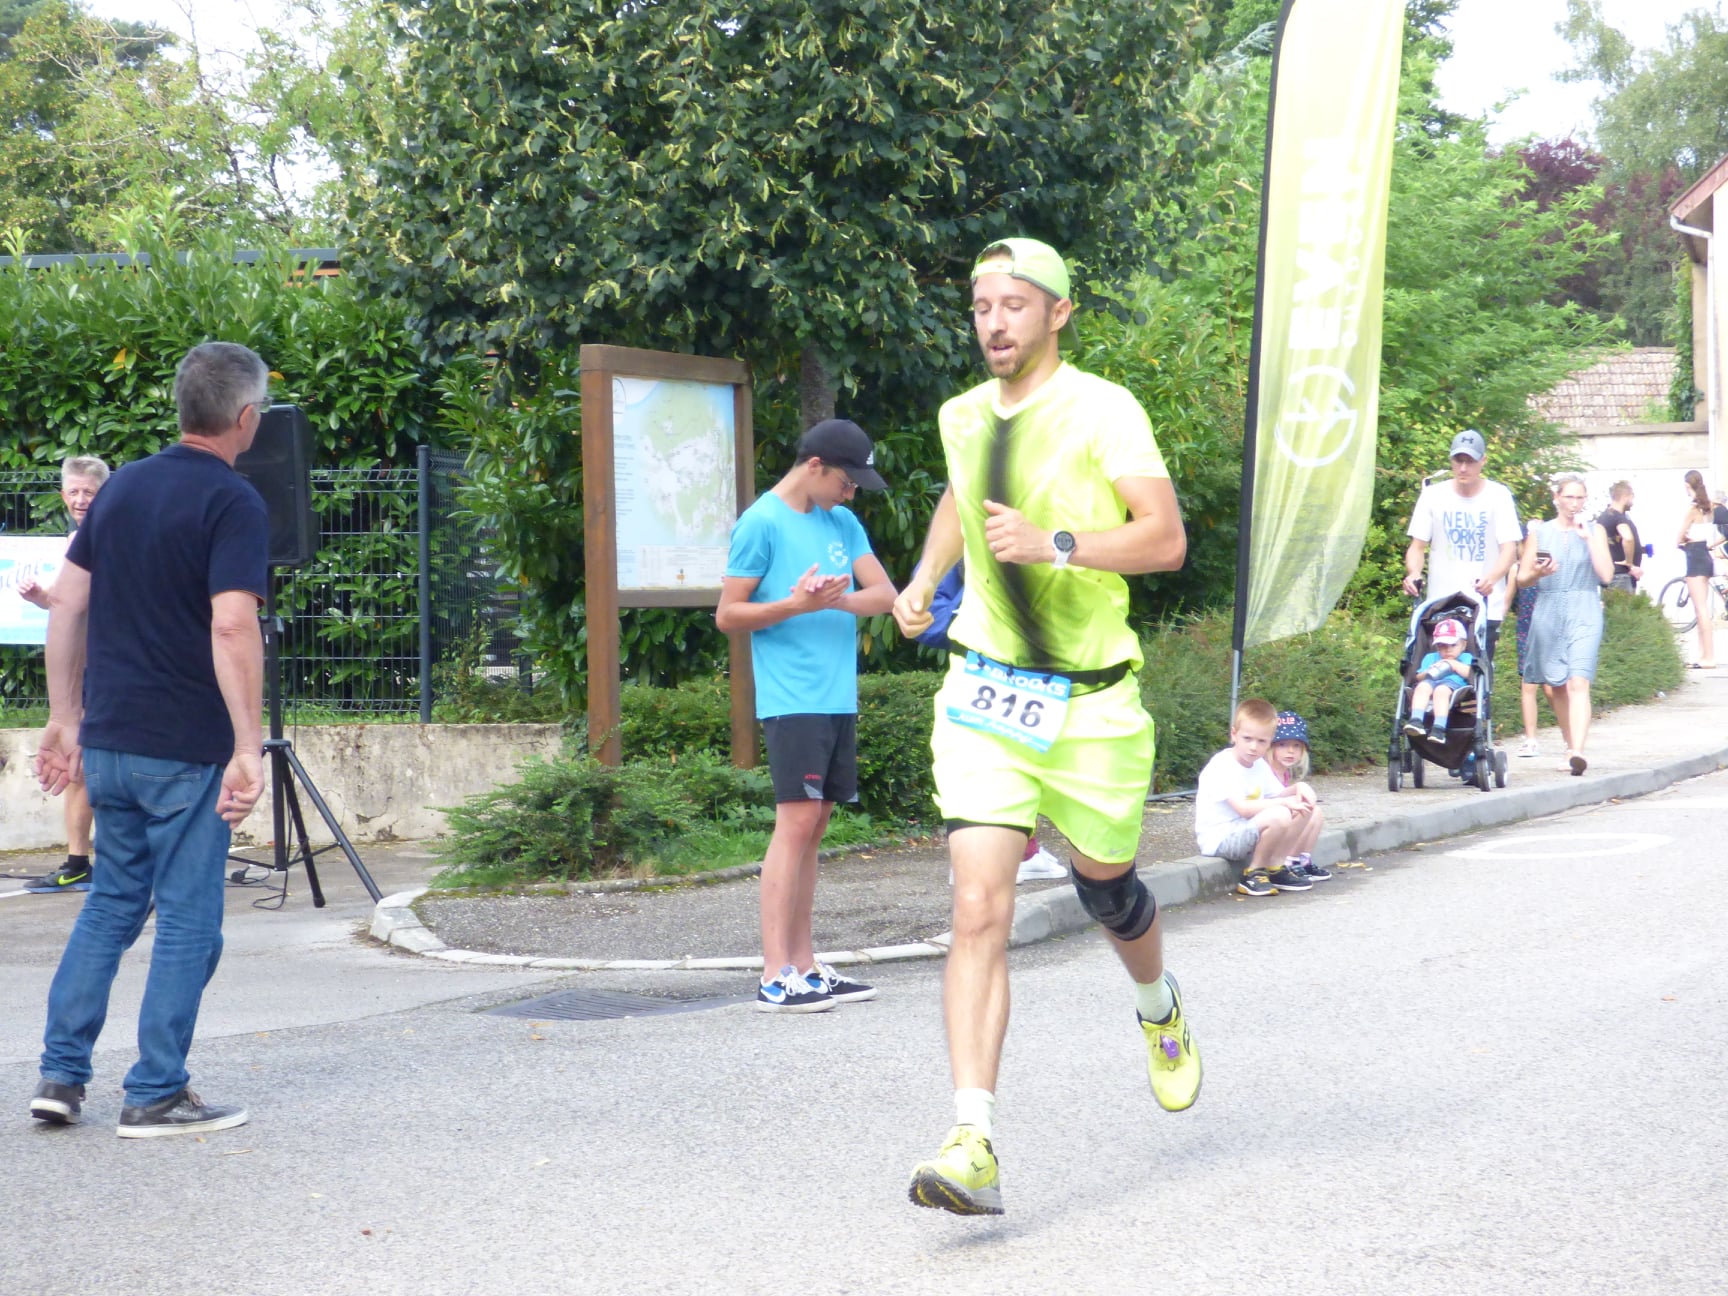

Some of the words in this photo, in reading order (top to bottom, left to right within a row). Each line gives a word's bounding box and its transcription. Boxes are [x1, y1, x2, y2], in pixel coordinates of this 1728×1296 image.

[1443, 511, 1476, 528] NEW
[1443, 529, 1476, 545] YORK
[1475, 511, 1488, 561] Brooklyn
[971, 685, 1044, 727] 816
